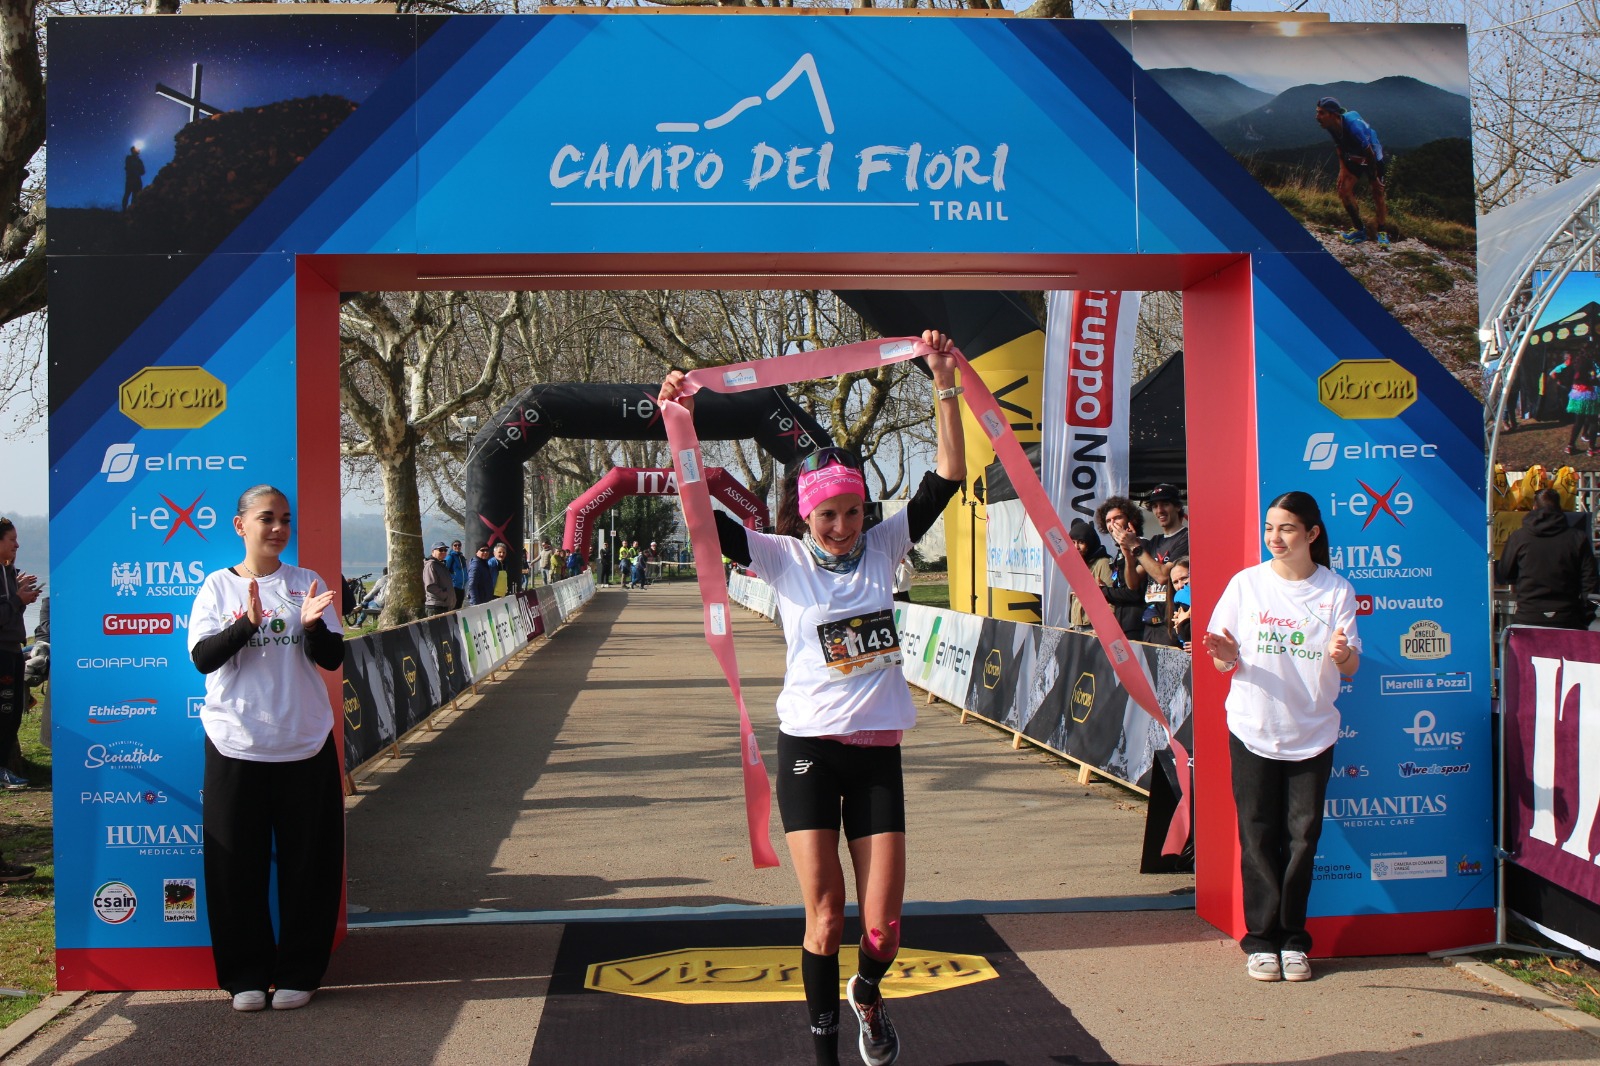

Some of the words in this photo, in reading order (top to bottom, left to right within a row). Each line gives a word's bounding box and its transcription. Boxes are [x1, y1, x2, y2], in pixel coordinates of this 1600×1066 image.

[549, 141, 724, 191] CAMPO
[743, 141, 834, 191] DEI
[855, 141, 1010, 192] FIORI
[930, 200, 1009, 221] TRAIL
[1070, 290, 1117, 421] ruppo
[125, 382, 224, 410] vibram
[1323, 374, 1415, 401] vibram
[1343, 441, 1438, 459] elmec
[145, 452, 247, 471] elmec
[636, 471, 679, 494] ITA
[1347, 544, 1402, 568] ITAS
[145, 560, 205, 585] ITAS
[1347, 567, 1432, 580] ASSICURAZIONI
[146, 585, 203, 597] ASSICURA
[1375, 595, 1443, 611] Novauto
[104, 614, 170, 634] Gruppo
[1259, 609, 1297, 629] Varese
[273, 635, 301, 646] YOU
[841, 627, 894, 657] 1143
[1258, 631, 1288, 642] MAY
[1414, 629, 1436, 638] ANGELO
[1257, 644, 1287, 655] HELP
[1290, 648, 1322, 660] YOU?
[1405, 637, 1446, 654] PORETTI
[77, 657, 168, 669] GIOIAPURA
[936, 637, 971, 676] elmec
[1385, 678, 1423, 690] Marelli
[1426, 678, 1434, 689] &
[1436, 677, 1466, 688] Pozzi
[88, 704, 158, 719] EthicSport
[84, 744, 164, 769] Scoiattolo
[1530, 655, 1600, 867] IT
[1343, 819, 1386, 828] MEDICAL
[1390, 818, 1415, 826] CARE
[139, 848, 186, 856] MEDICAL
[1312, 863, 1351, 873] Regione
[1312, 872, 1362, 881] Lombardia
[94, 893, 137, 908] csain
[614, 958, 981, 987] vibrm
